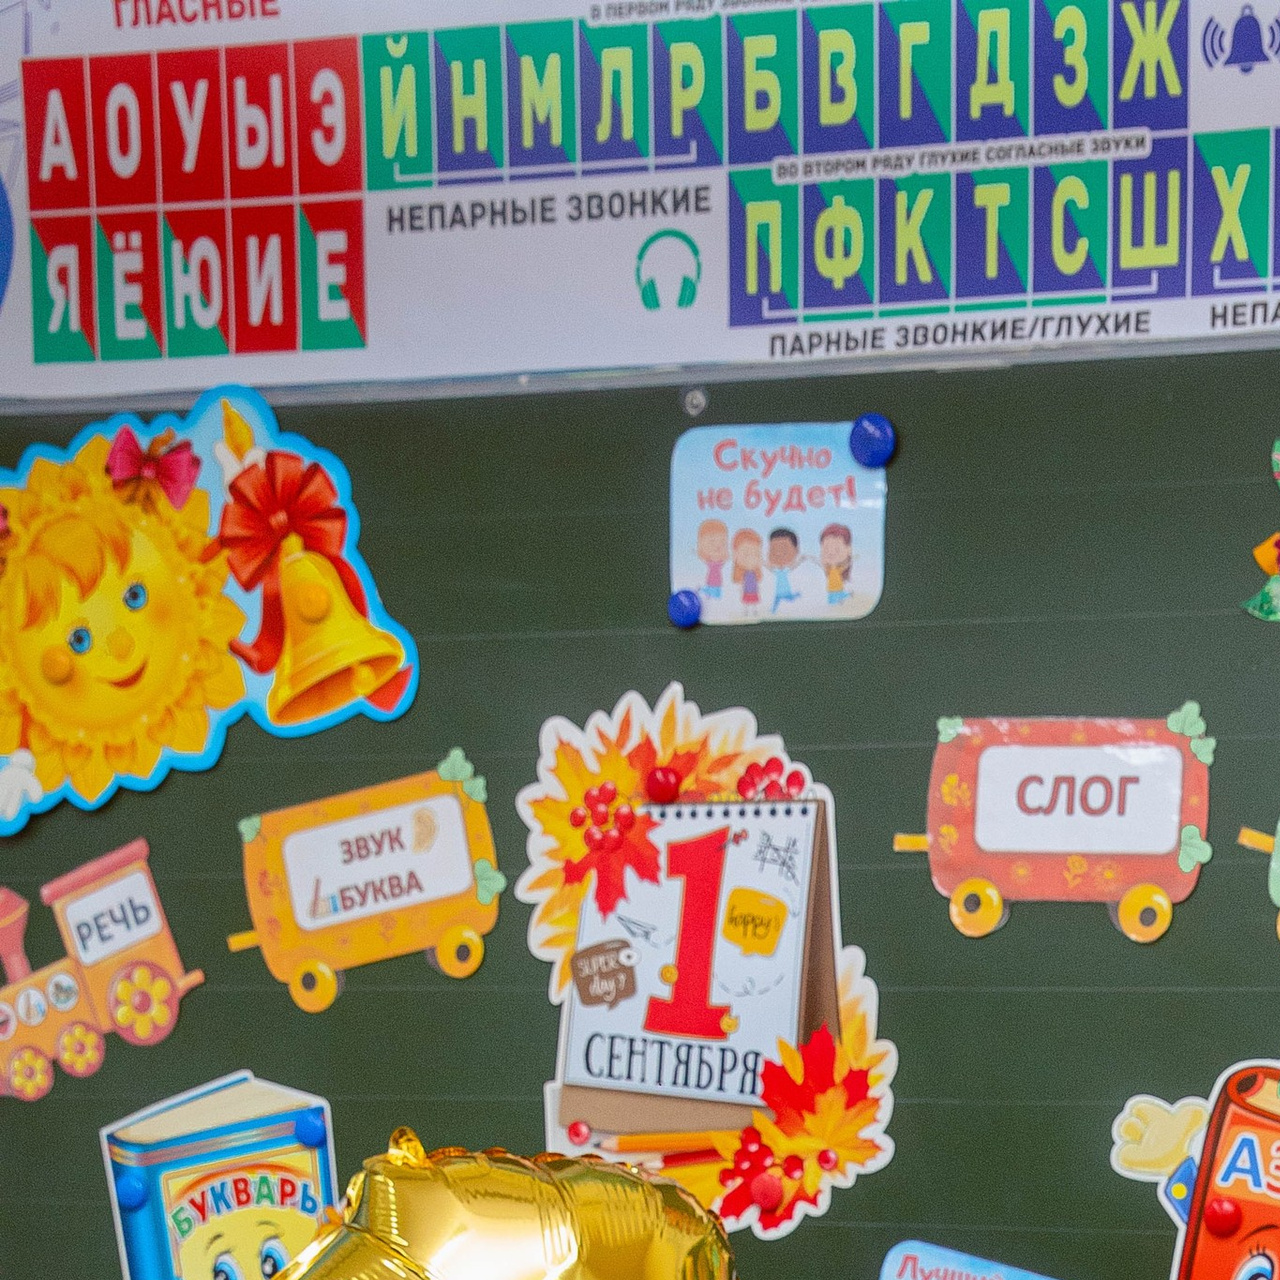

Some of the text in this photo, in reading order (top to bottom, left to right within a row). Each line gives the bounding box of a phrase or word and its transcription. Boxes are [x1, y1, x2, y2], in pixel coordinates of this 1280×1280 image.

[379, 35, 706, 159] Й Н М Л Р
[743, 0, 1183, 133] Б В Г Д З Ж
[39, 67, 347, 181] А О У Ы Э
[386, 185, 713, 234] НЕПАРНЫЕ ЗВОНКИЕ
[745, 169, 1181, 296] П Ф К Т С Ш
[1210, 163, 1252, 264] Х
[47, 230, 350, 340] Я Ё Ю И Е
[769, 310, 1151, 357] ПАРНЫЕ ЗВОНКИЕ/ГЛУХИЕ
[713, 439, 832, 478] Скучно
[697, 475, 857, 518] не будет!
[1016, 774, 1141, 818] СЛОГ
[339, 825, 407, 865] ЗВУК
[338, 870, 424, 912] БУКВА
[75, 897, 152, 951] РЕЧЬ
[643, 826, 733, 1041] 1
[585, 1032, 763, 1096] СЕНТЯБРЯ
[171, 1175, 320, 1238] БУКВАРЬ
